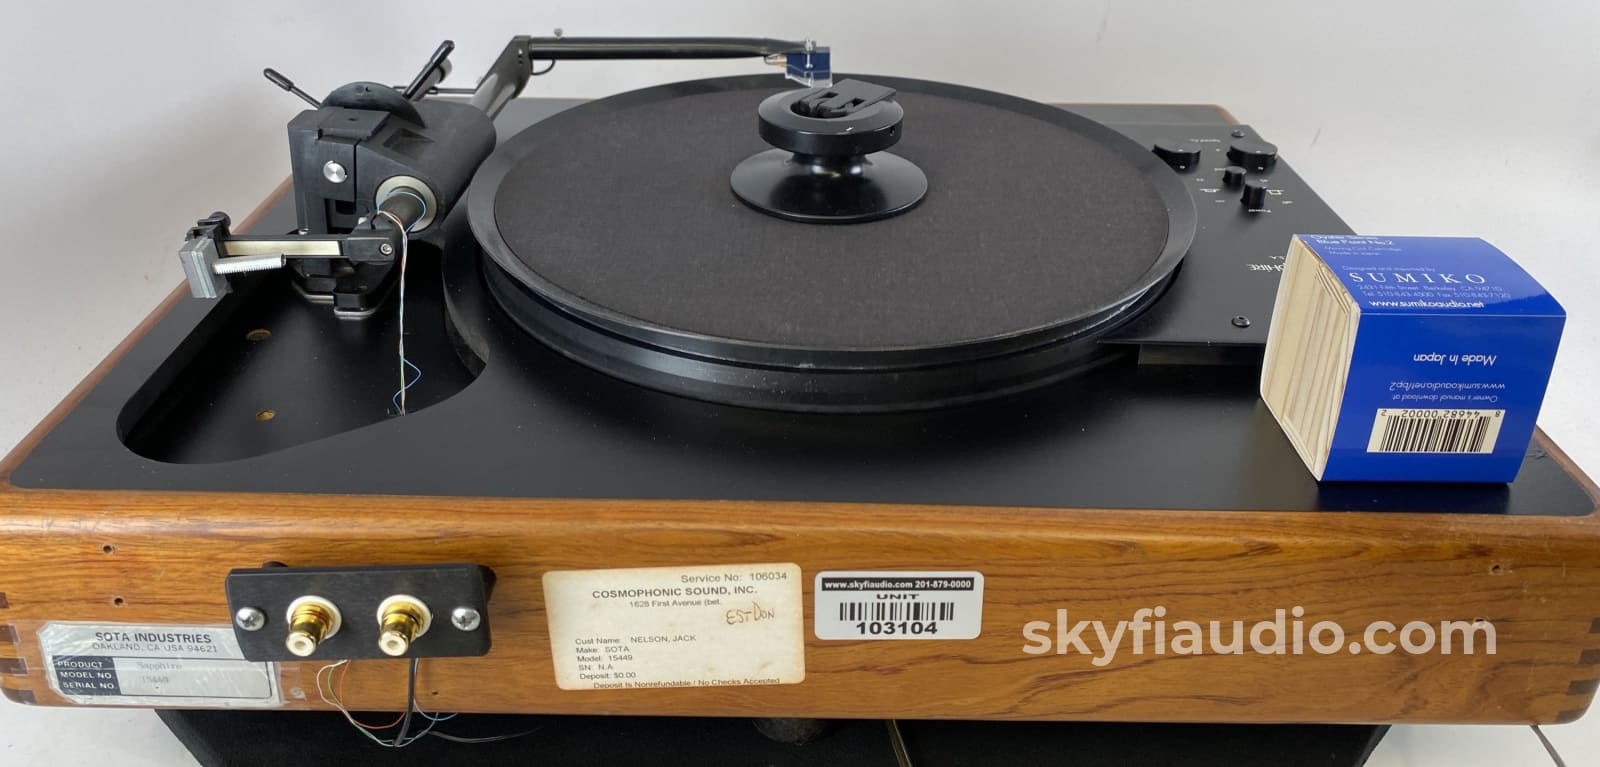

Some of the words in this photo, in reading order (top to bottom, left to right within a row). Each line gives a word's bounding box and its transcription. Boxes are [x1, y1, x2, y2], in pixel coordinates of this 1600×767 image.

[1349, 272, 1486, 284] SUMIKO
[1413, 352, 1446, 366] Japan
[1450, 355, 1458, 365] In
[1462, 355, 1496, 366] Made
[1390, 382, 1505, 391] www.sumikoaudio.net/bp2
[750, 572, 787, 581] 106034
[825, 580, 912, 590] www.skyfiaudio.com
[592, 588, 682, 598] COSMOPHONIC
[686, 587, 731, 596] SOUND,
[734, 586, 757, 594] INC.
[856, 622, 937, 634] 103104
[95, 632, 129, 642] SOTA
[135, 634, 211, 643] INDUSTRIES
[630, 636, 670, 644] NELSON,
